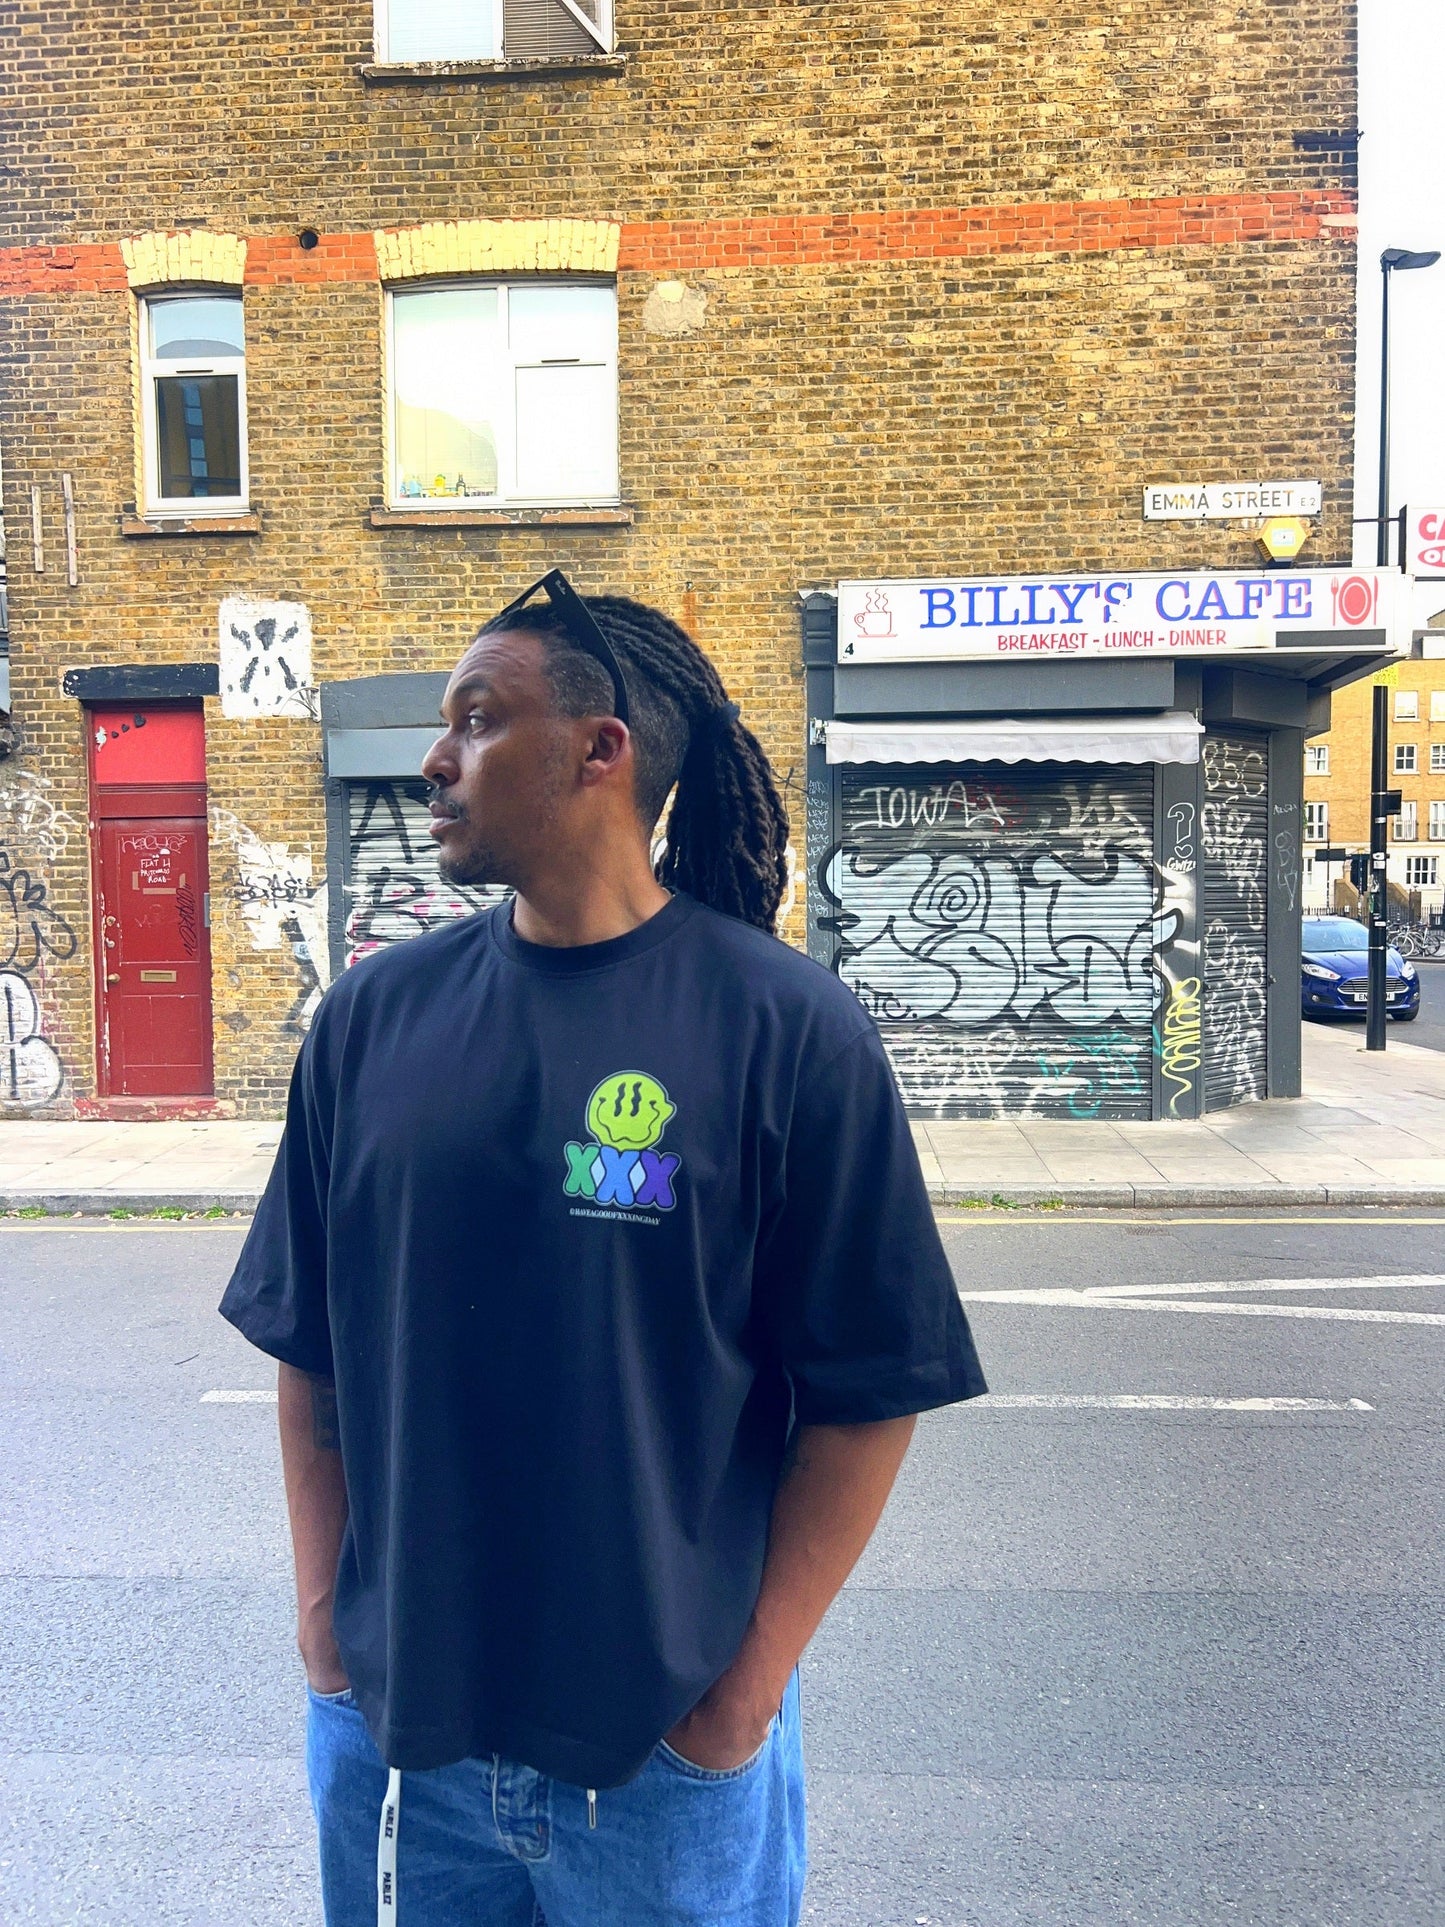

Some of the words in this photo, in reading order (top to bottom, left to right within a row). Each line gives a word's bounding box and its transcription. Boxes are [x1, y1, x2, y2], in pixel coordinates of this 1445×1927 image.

[1152, 493, 1209, 510] EMMA
[1222, 490, 1294, 509] STREET
[1155, 578, 1312, 622] CAFE
[844, 643, 854, 656] 4
[997, 632, 1088, 651] BREAKFAST
[1104, 630, 1153, 648] LUNCH
[1169, 629, 1227, 646] DINNER
[140, 858, 160, 869] FLAT
[565, 1142, 680, 1209] XXX
